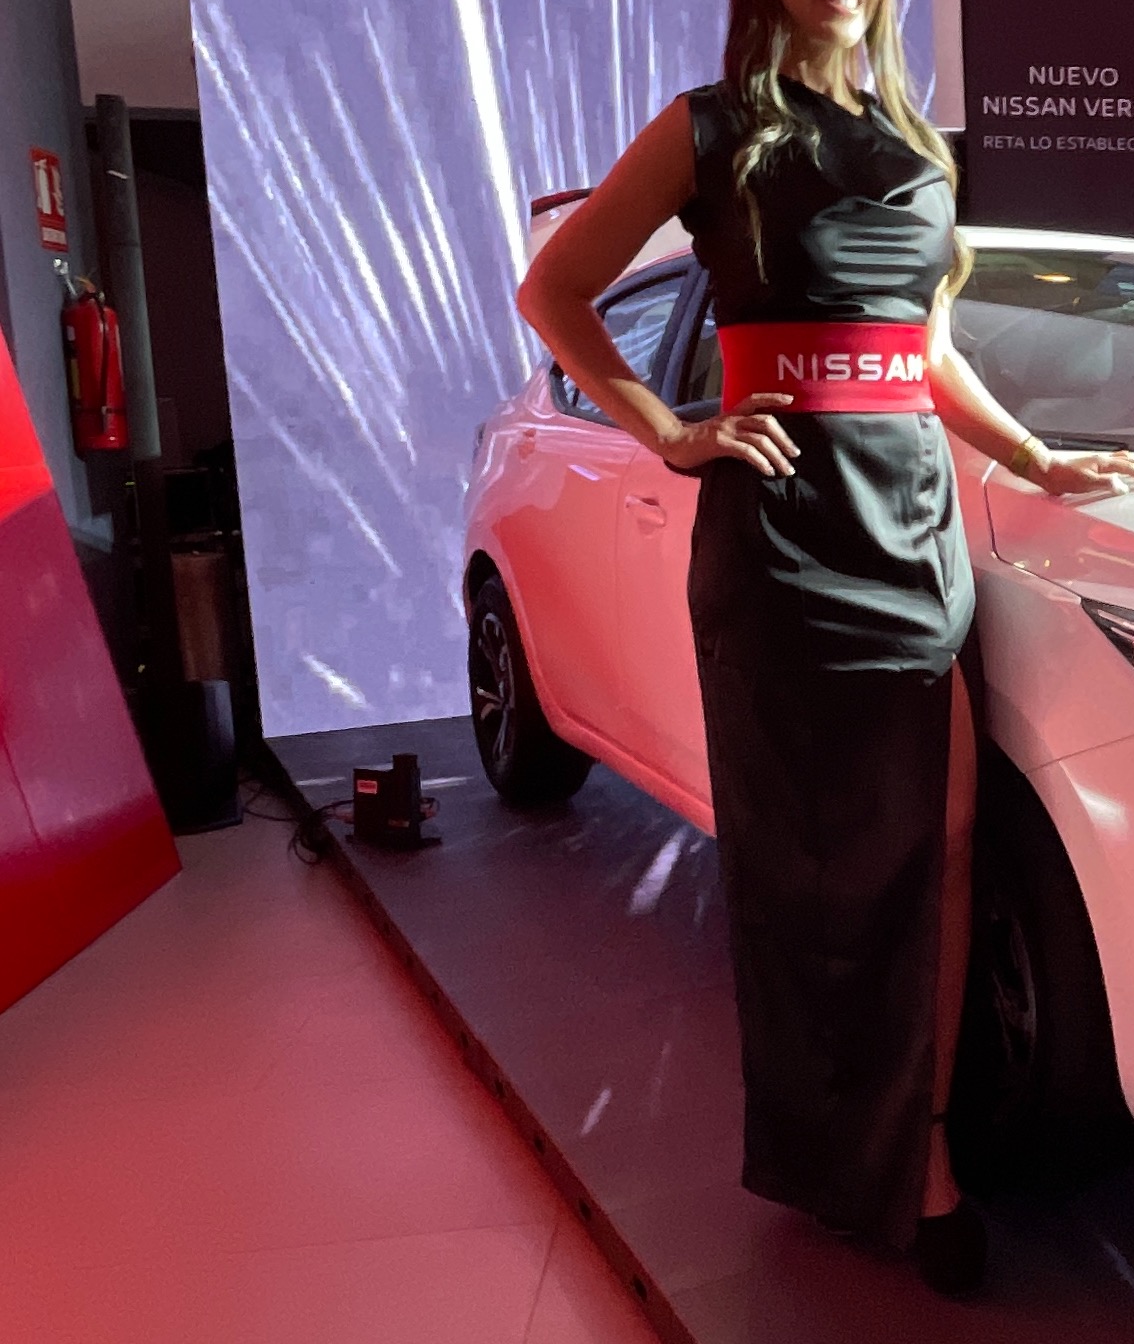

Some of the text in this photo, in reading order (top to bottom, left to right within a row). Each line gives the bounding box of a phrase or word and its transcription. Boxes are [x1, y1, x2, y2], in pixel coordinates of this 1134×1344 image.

[1029, 66, 1119, 86] NUEVO
[983, 96, 1076, 116] NISSAN
[983, 135, 1025, 149] RETA
[1030, 136, 1051, 150] LO
[777, 354, 923, 381] NISSAN
